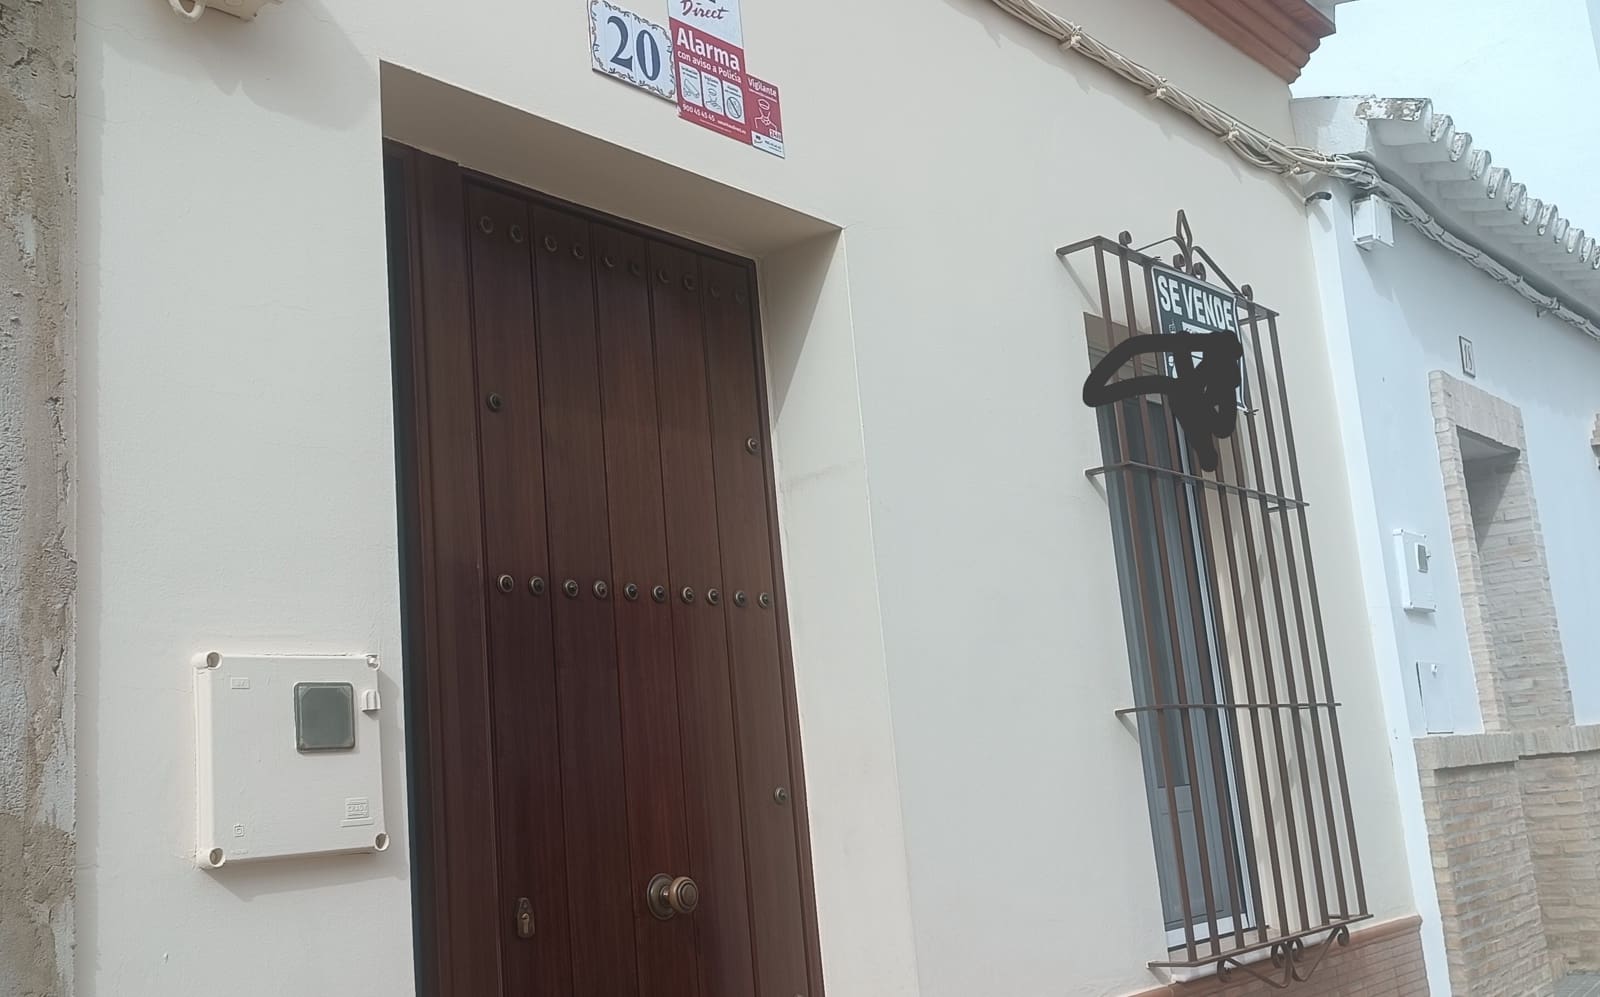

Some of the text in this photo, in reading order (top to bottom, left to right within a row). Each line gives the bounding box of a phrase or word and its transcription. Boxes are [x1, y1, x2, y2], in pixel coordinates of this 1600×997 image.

[680, 0, 729, 20] Direct
[606, 15, 661, 82] 20
[676, 27, 740, 72] Alarma
[678, 51, 691, 62] con
[692, 57, 711, 71] aviso
[747, 77, 777, 97] Vigilante
[1157, 275, 1235, 331] SE VENDE
